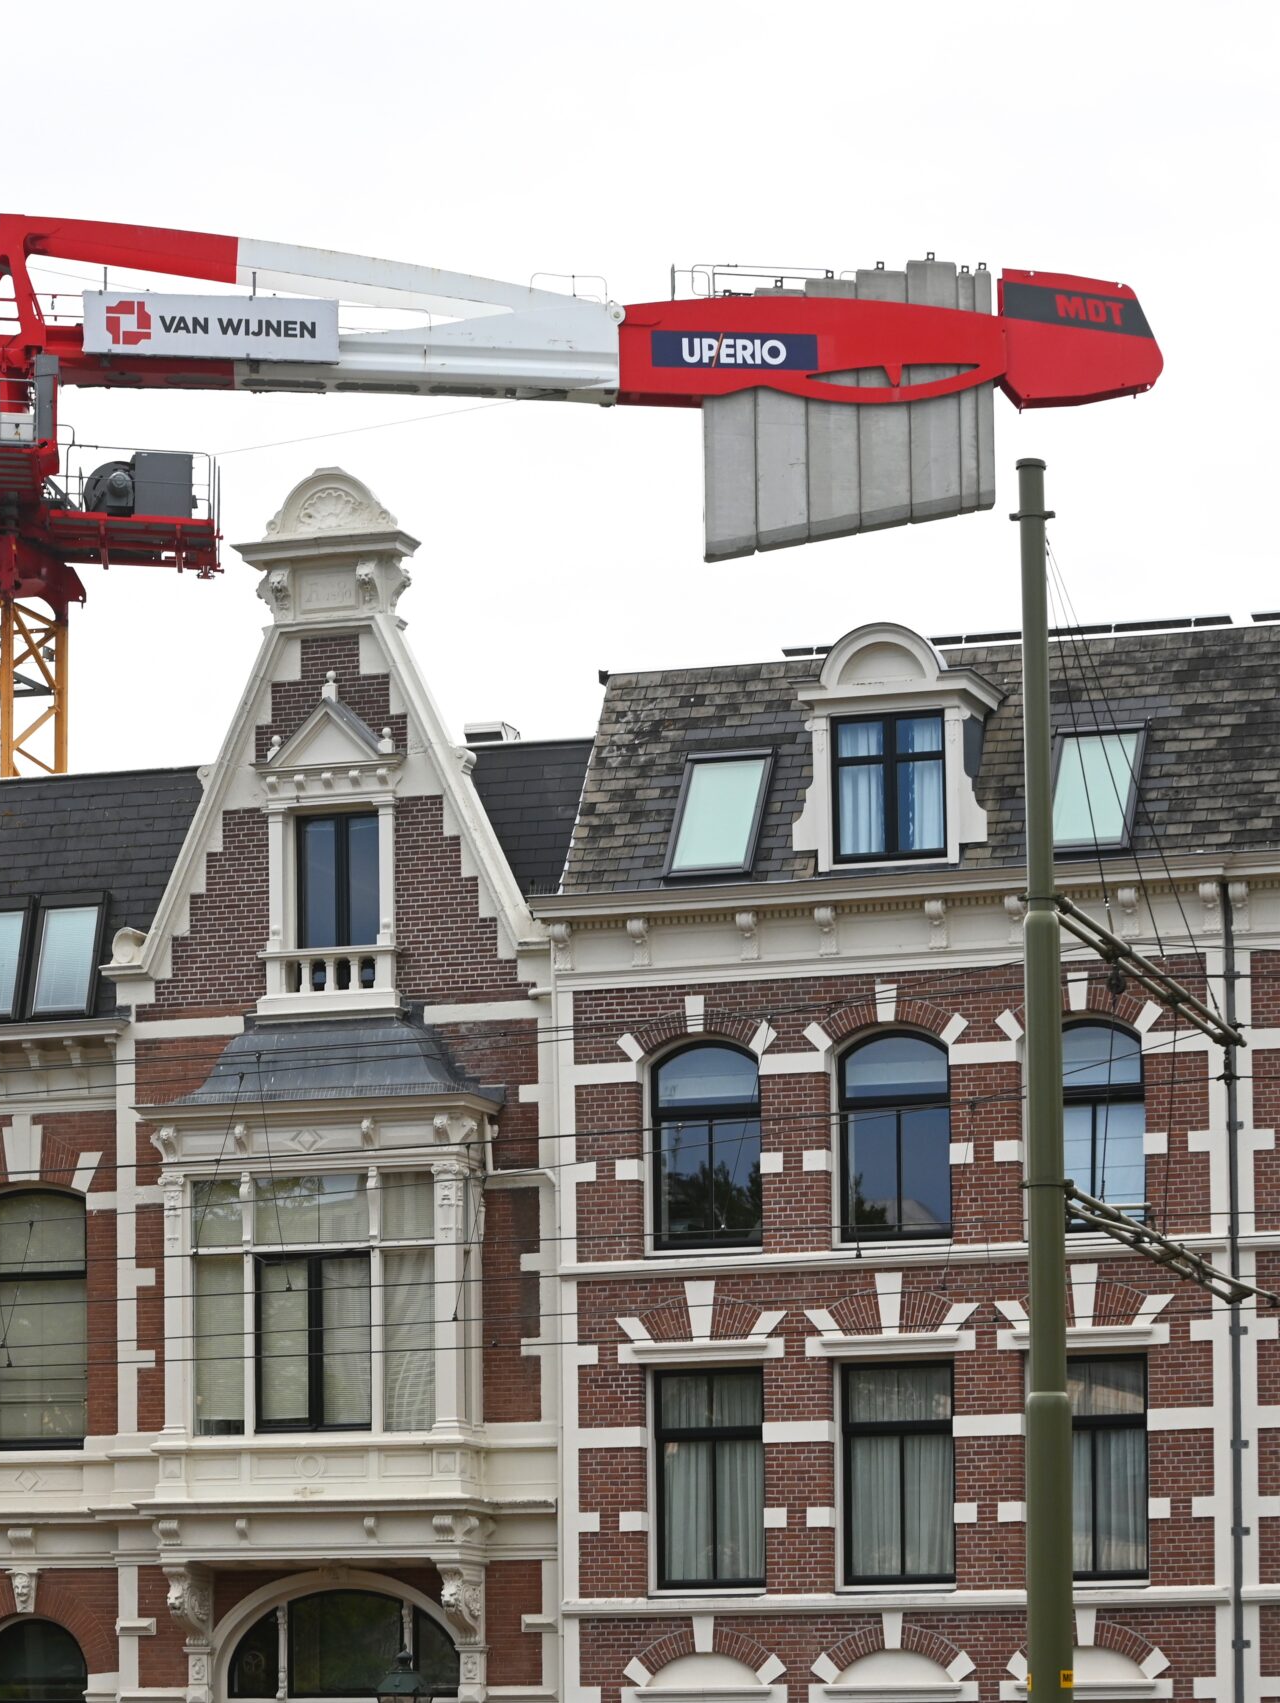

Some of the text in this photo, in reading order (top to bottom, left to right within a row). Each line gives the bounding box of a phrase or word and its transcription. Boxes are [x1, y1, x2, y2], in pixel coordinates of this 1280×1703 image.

[1055, 294, 1124, 326] MDT
[159, 315, 317, 339] VAN WIJNEN
